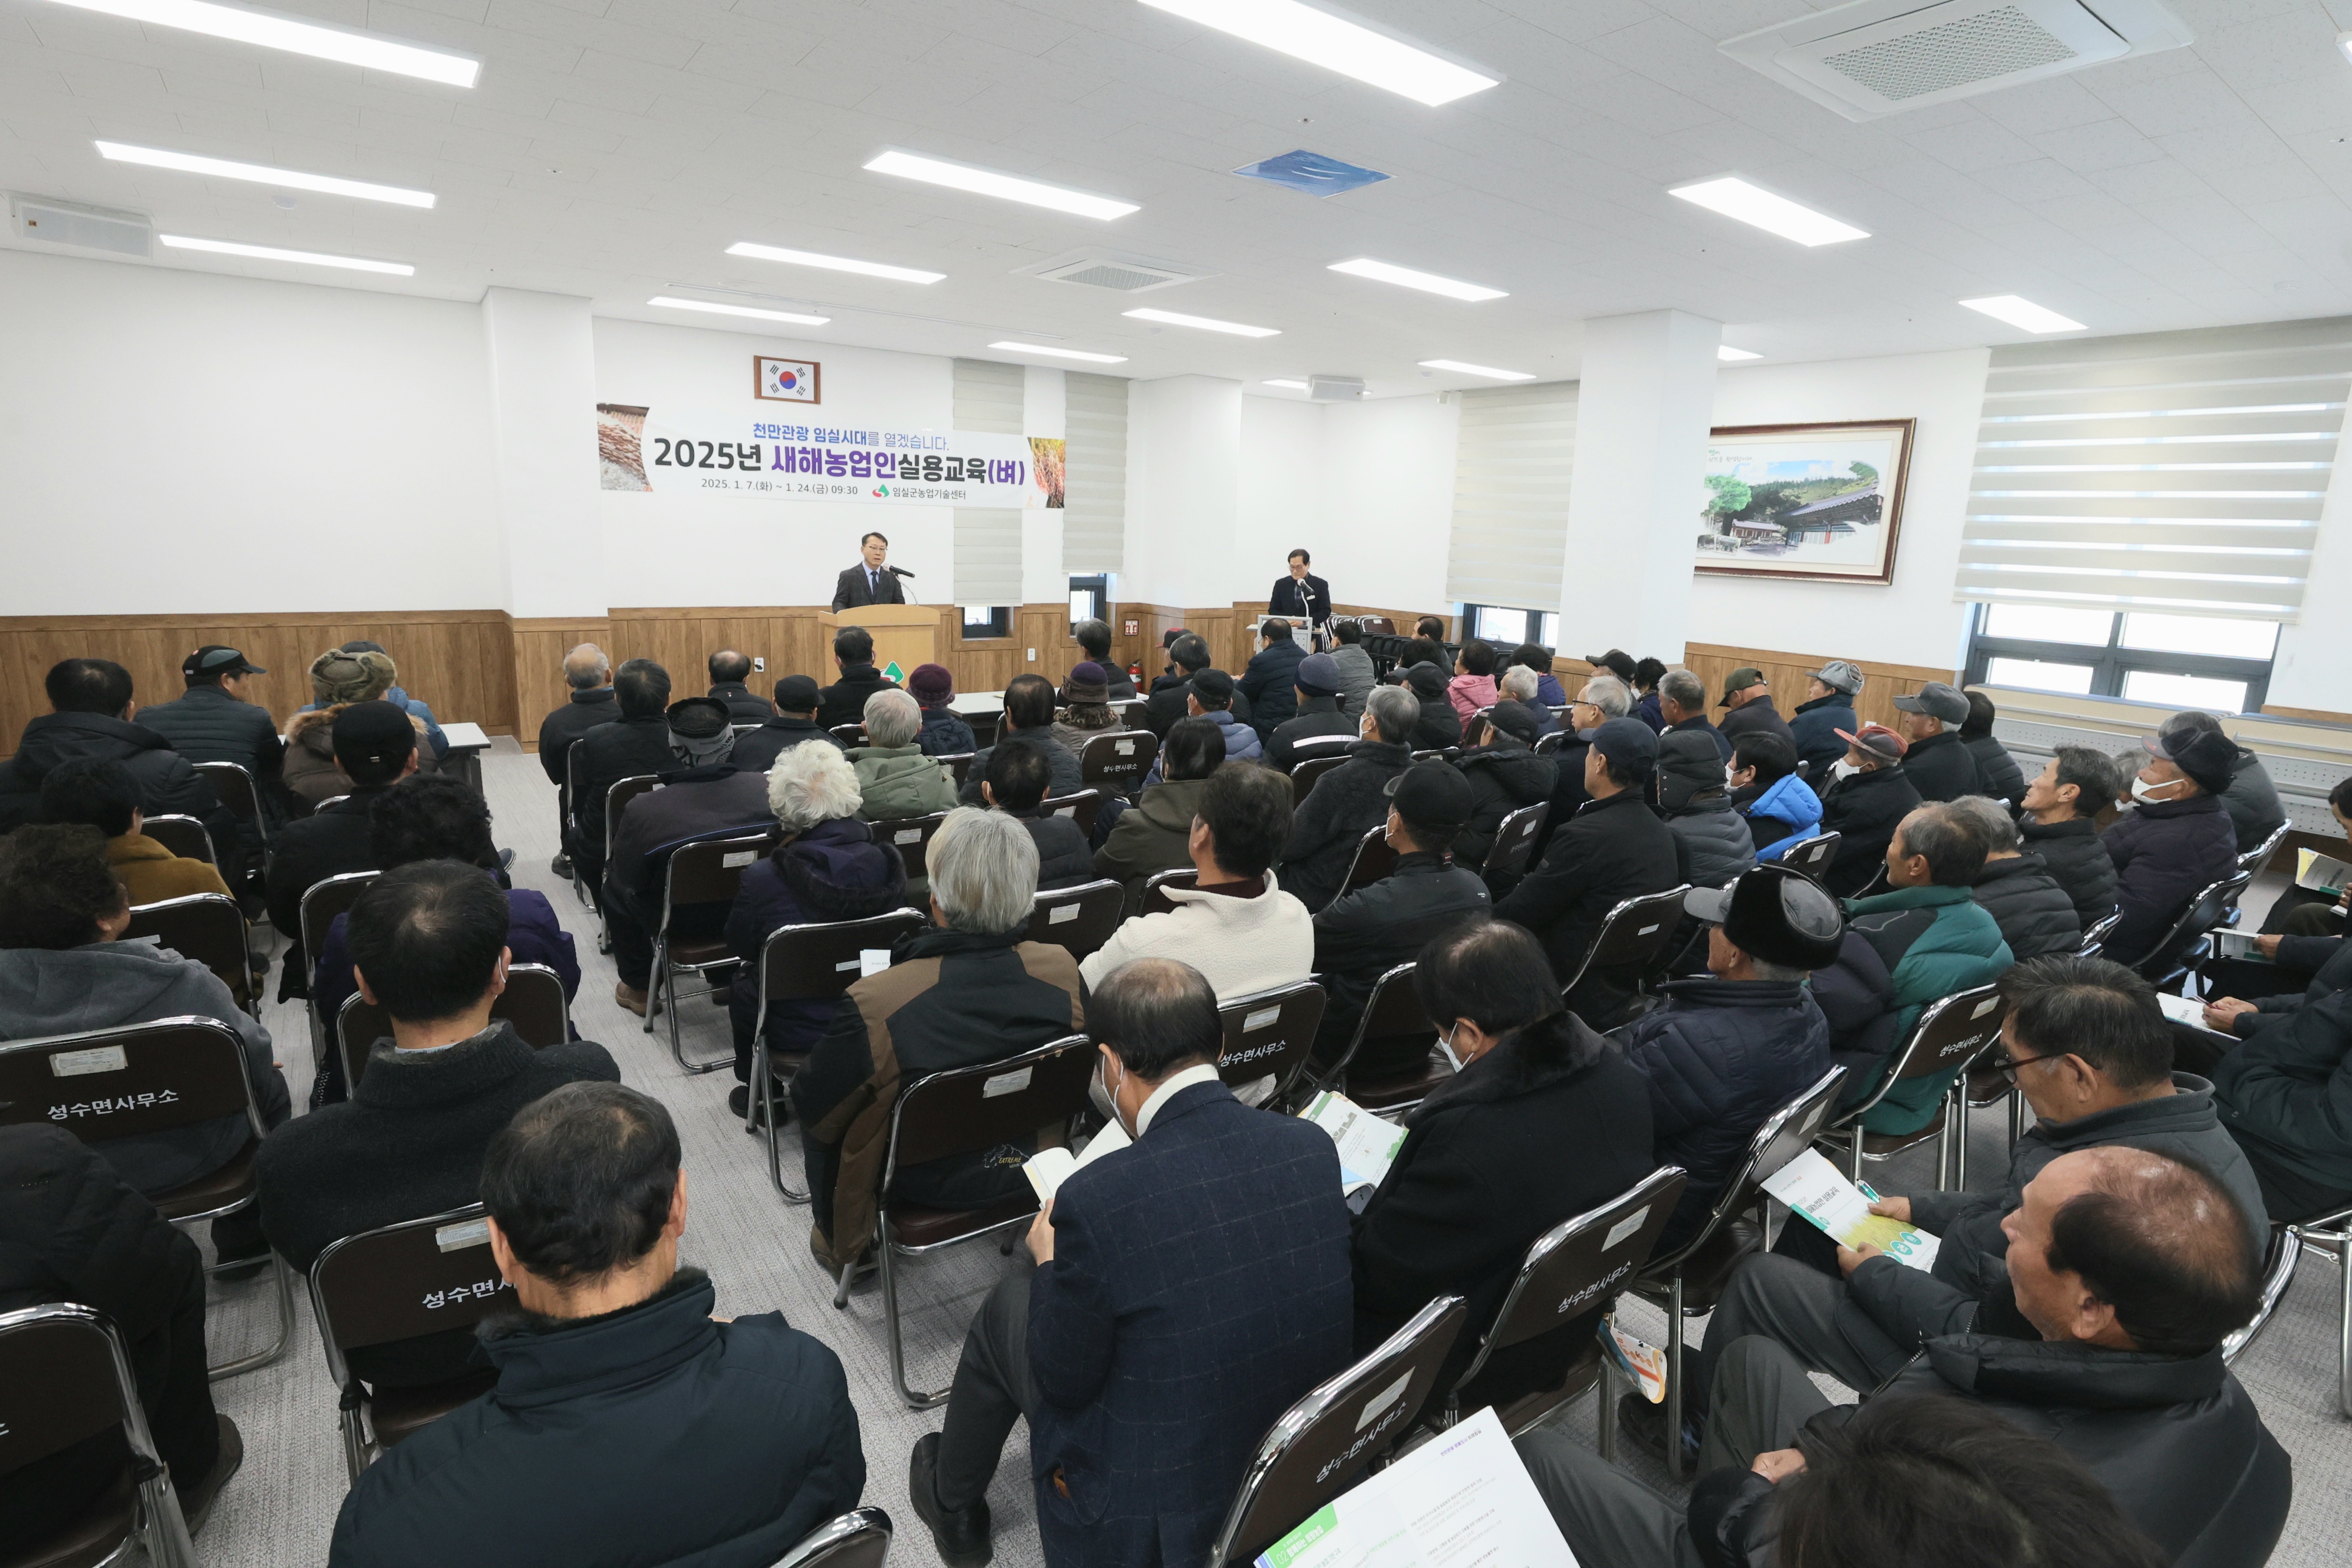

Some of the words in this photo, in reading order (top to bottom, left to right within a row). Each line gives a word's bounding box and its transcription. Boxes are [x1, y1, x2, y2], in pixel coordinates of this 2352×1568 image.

[753, 422, 809, 441] 천만관광
[813, 427, 880, 447] 임실시대를
[884, 433, 949, 451] 열겠습니다.
[654, 438, 761, 471] 2025년
[771, 445, 1025, 485] 새해농업인실용교육(벼)
[701, 478, 730, 489] 2025.
[734, 481, 742, 489] 1.
[746, 481, 772, 492] 7.(화)
[786, 483, 794, 492] 1.
[798, 483, 828, 495] 24.(금)
[832, 485, 858, 495] 09:30
[893, 487, 966, 500] 임실군농업기술센터
[1103, 763, 1137, 772] 성수면사무소
[1220, 1040, 1286, 1067] 성수면사무소
[1939, 1033, 1982, 1057] 성수면사무소
[48, 1089, 179, 1120] 성수면사무소
[1558, 1260, 1632, 1313] 성수면사무소
[1316, 1401, 1407, 1483] 성수면사무소
[1276, 1551, 1289, 1565] 02
